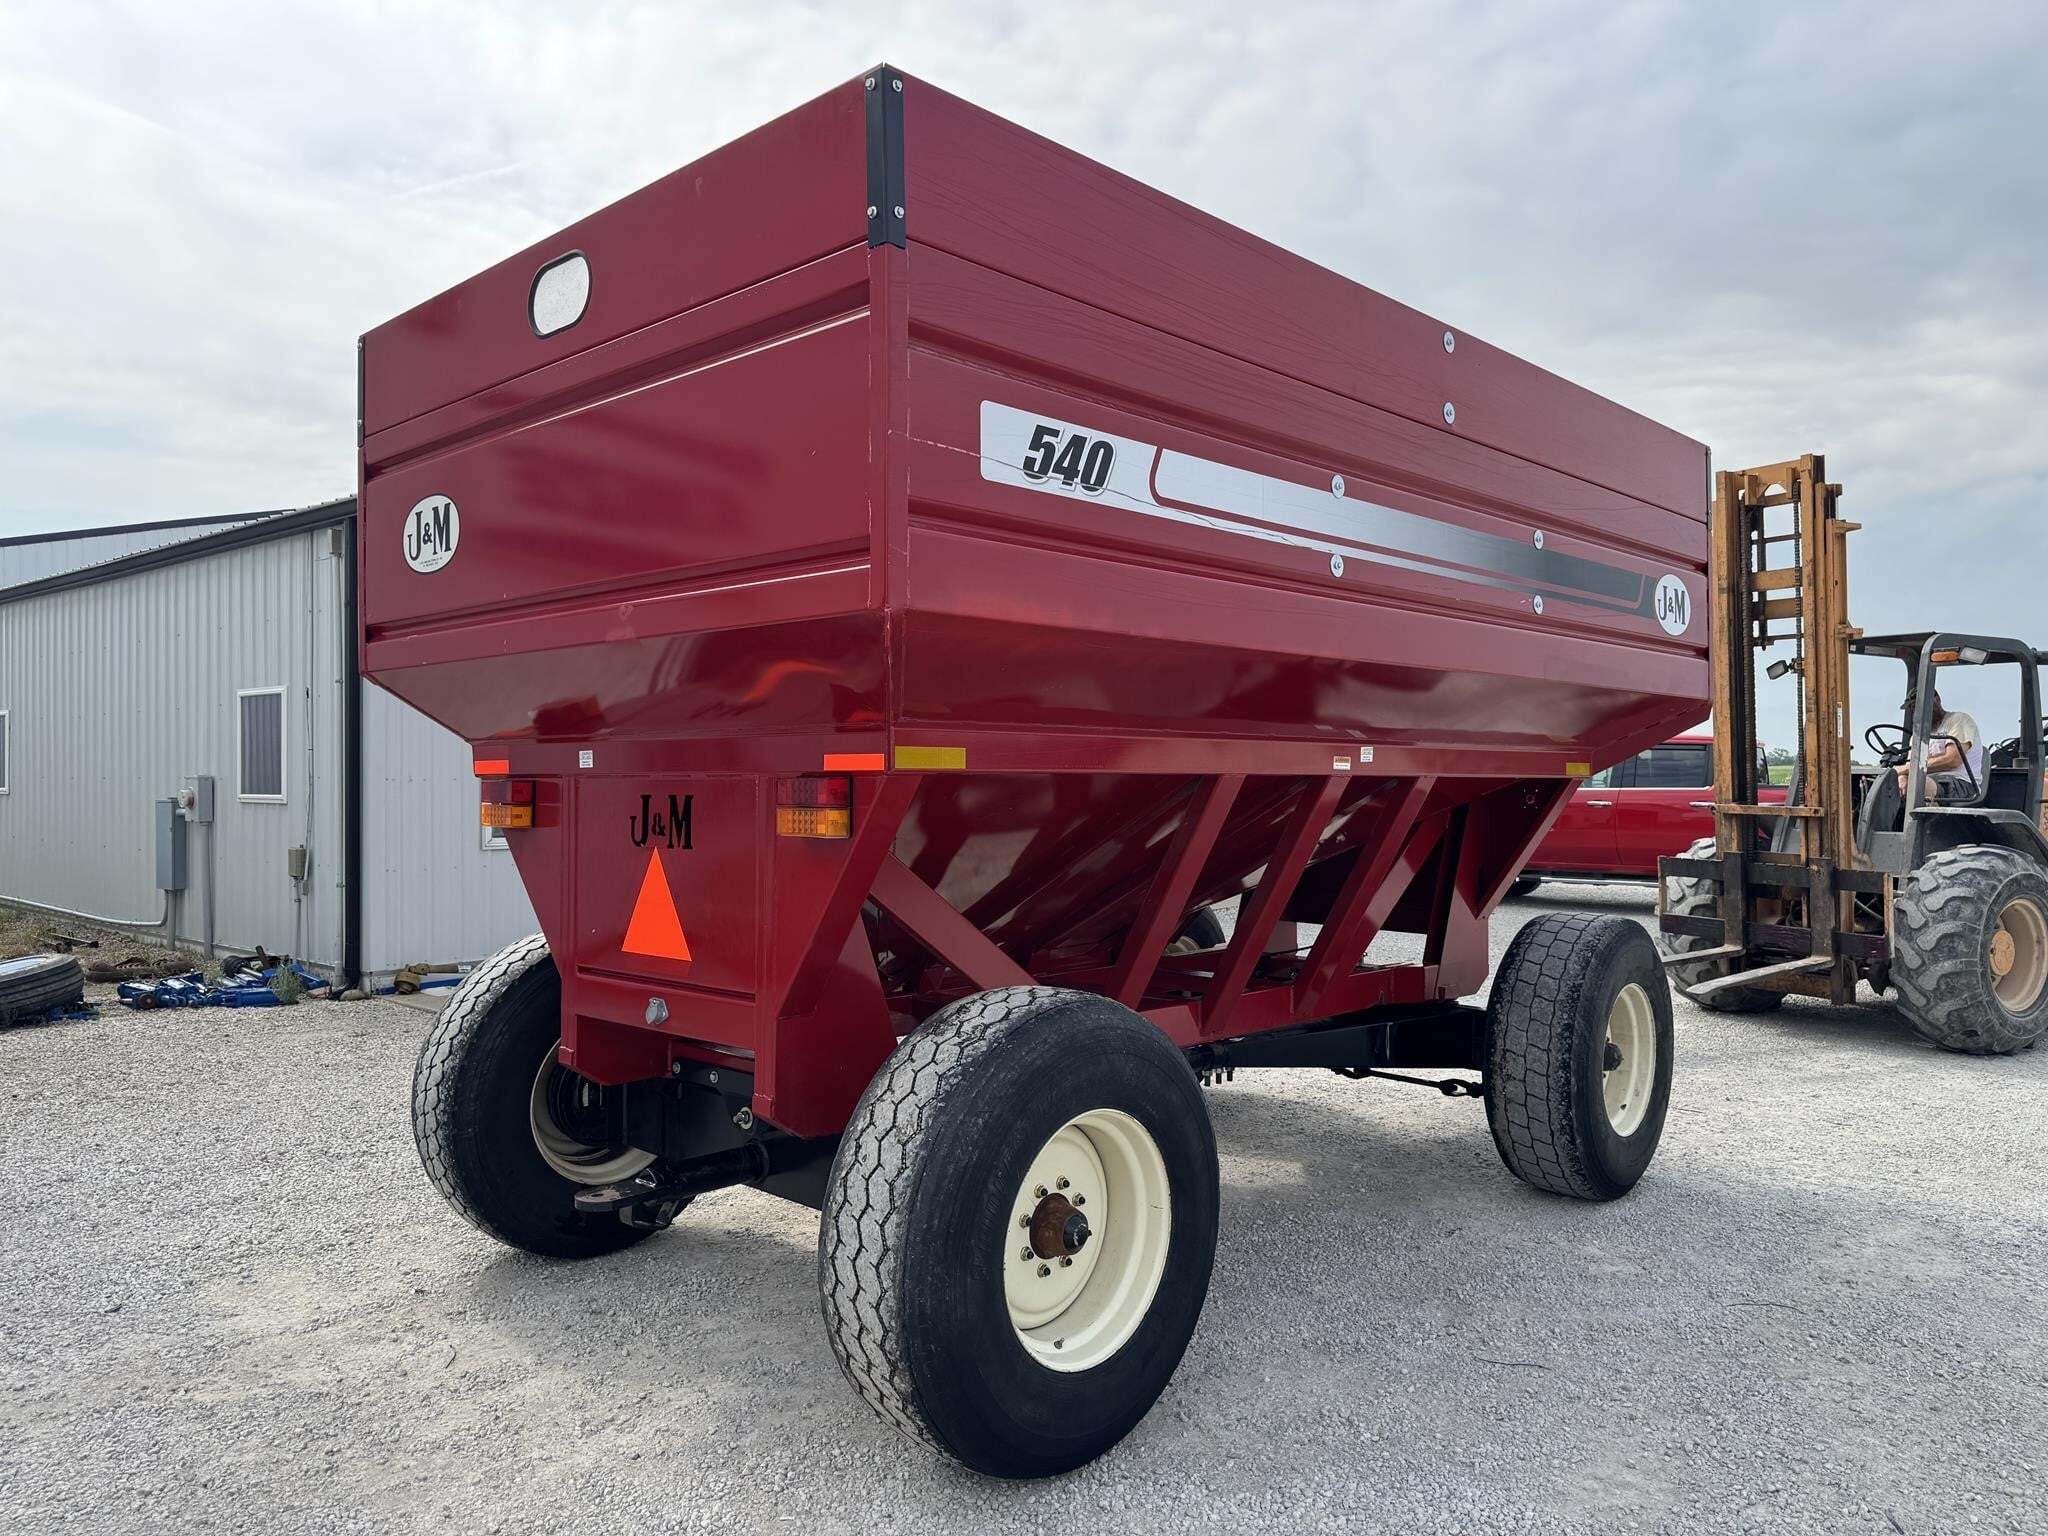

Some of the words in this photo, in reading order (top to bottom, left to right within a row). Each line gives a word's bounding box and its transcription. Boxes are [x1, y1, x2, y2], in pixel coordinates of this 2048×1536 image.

[1023, 424, 1115, 492] 540
[407, 502, 451, 561] J&M
[1657, 585, 1686, 625] J&M
[629, 794, 694, 849] J&M
